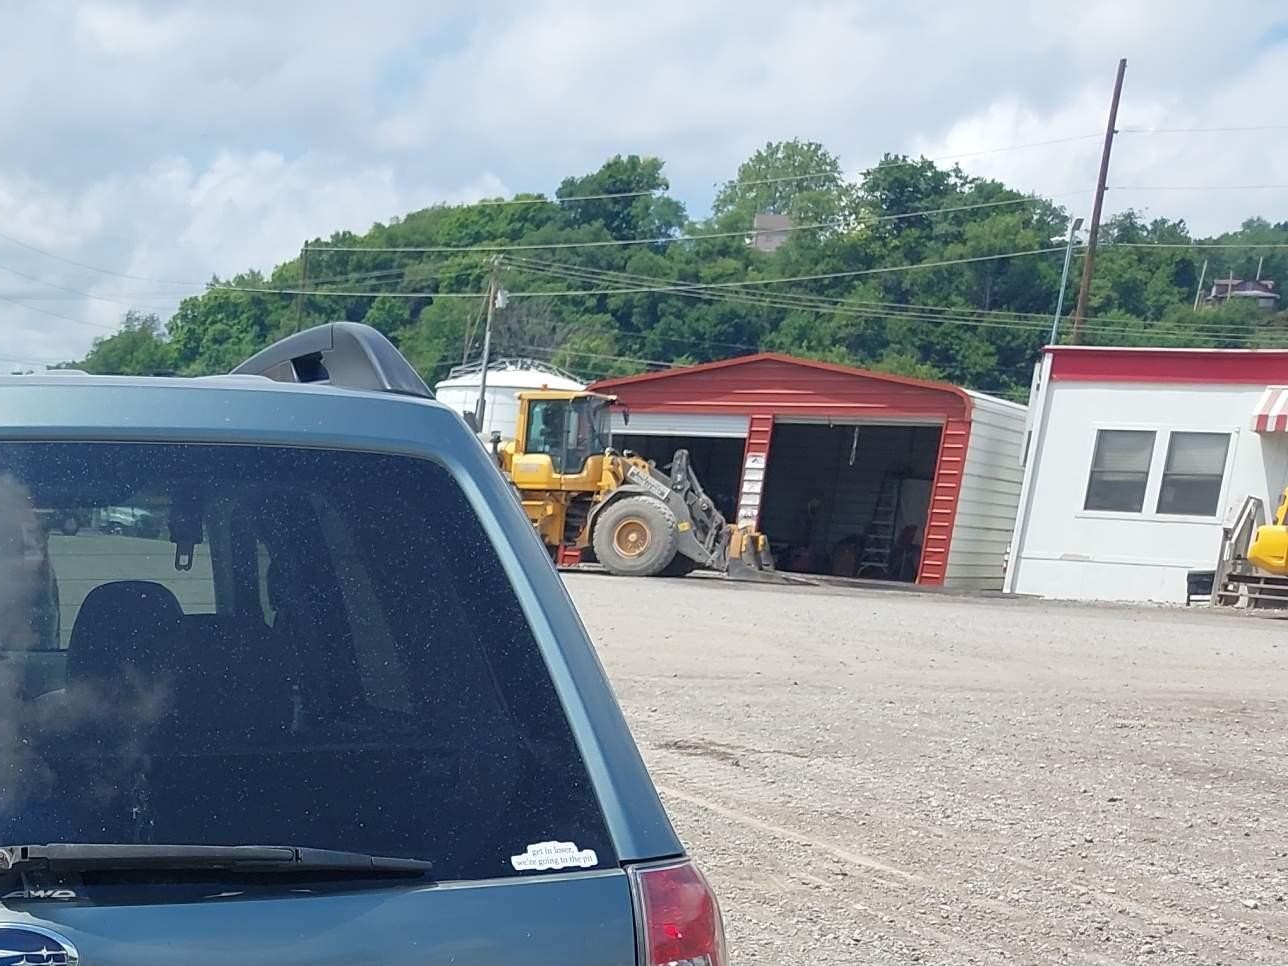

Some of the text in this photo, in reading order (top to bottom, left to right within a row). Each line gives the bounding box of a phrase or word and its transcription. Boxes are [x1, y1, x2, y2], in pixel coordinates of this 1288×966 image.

[532, 848, 544, 857] get
[538, 856, 560, 867] going
[569, 855, 582, 863] the
[583, 855, 593, 864] pit
[2, 889, 77, 899] AWD
